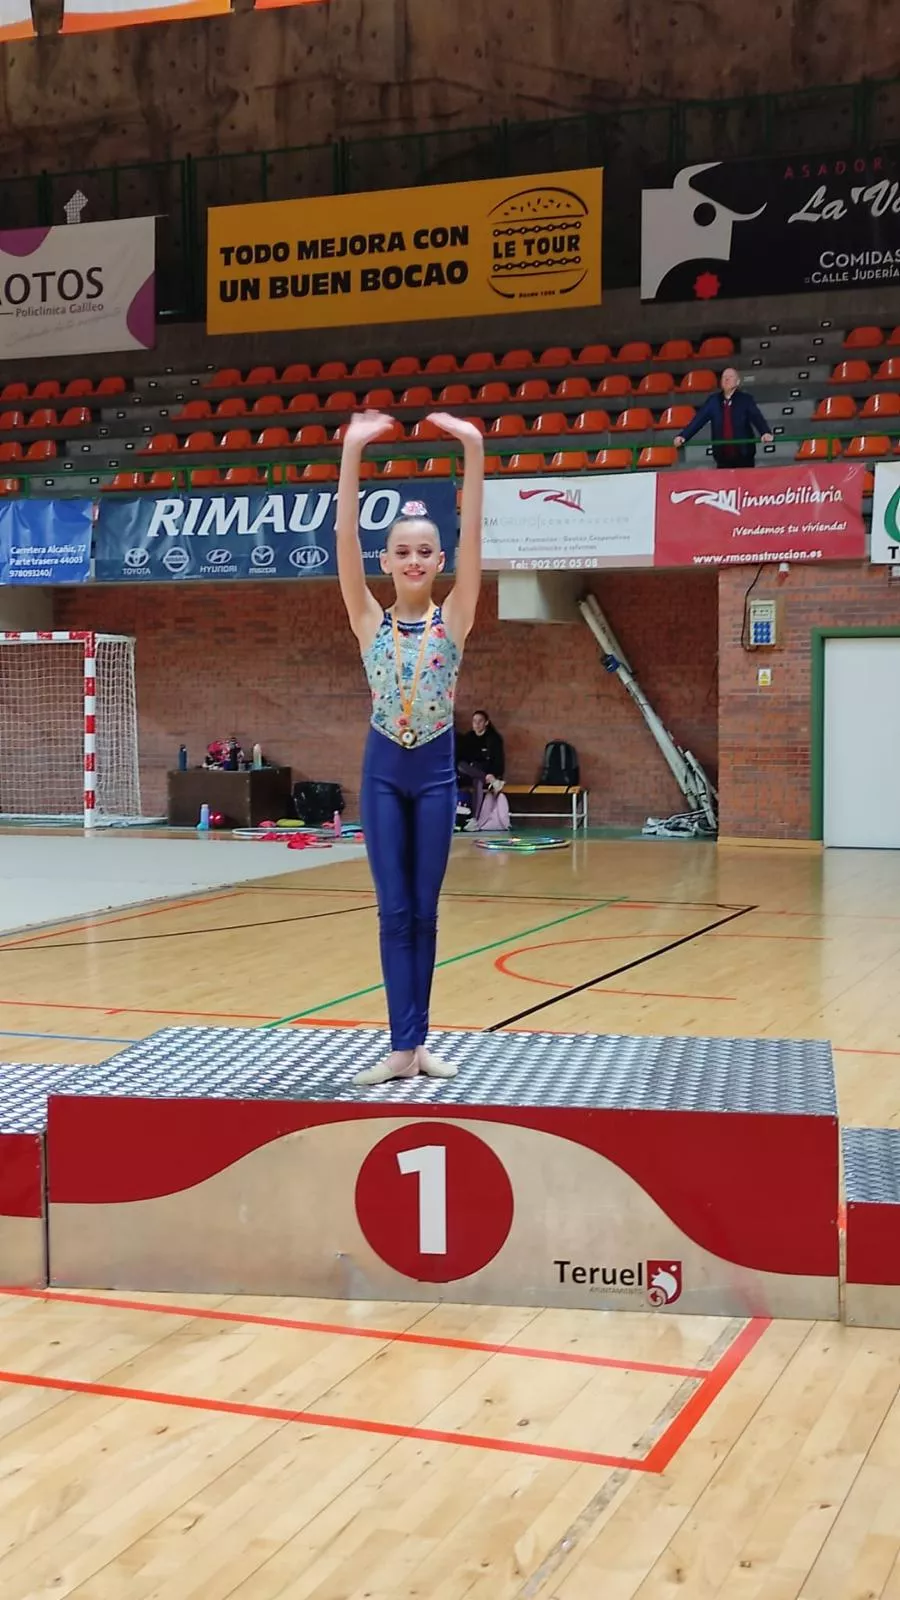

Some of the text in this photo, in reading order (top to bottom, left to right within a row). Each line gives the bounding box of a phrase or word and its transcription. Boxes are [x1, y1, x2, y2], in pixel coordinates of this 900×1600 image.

[784, 157, 883, 180] ASADOR
[787, 184, 848, 223] La
[220, 225, 469, 266] TODO MEJORA CON
[493, 234, 581, 259] LE TOUR
[219, 259, 469, 303] UN BUEN BOCAO
[811, 271, 849, 284] CALLE
[0, 266, 104, 306] OTOS
[69, 302, 104, 314] Galileo
[742, 484, 843, 508] inmobiliaria
[732, 521, 847, 537] ¡Vendemos tu vivienda!
[10, 546, 46, 554] Carretera
[295, 550, 321, 564] KIA
[692, 549, 823, 565] www.rmconstruccion.es
[9, 557, 32, 566] Parte
[32, 557, 59, 565] trasera
[200, 564, 238, 573] HYUNDAI
[510, 557, 599, 570] Tel: 902 02 05 08
[122, 567, 151, 575] TOYOTA
[396, 1145, 447, 1255] 1
[553, 1260, 644, 1287] Teruel
